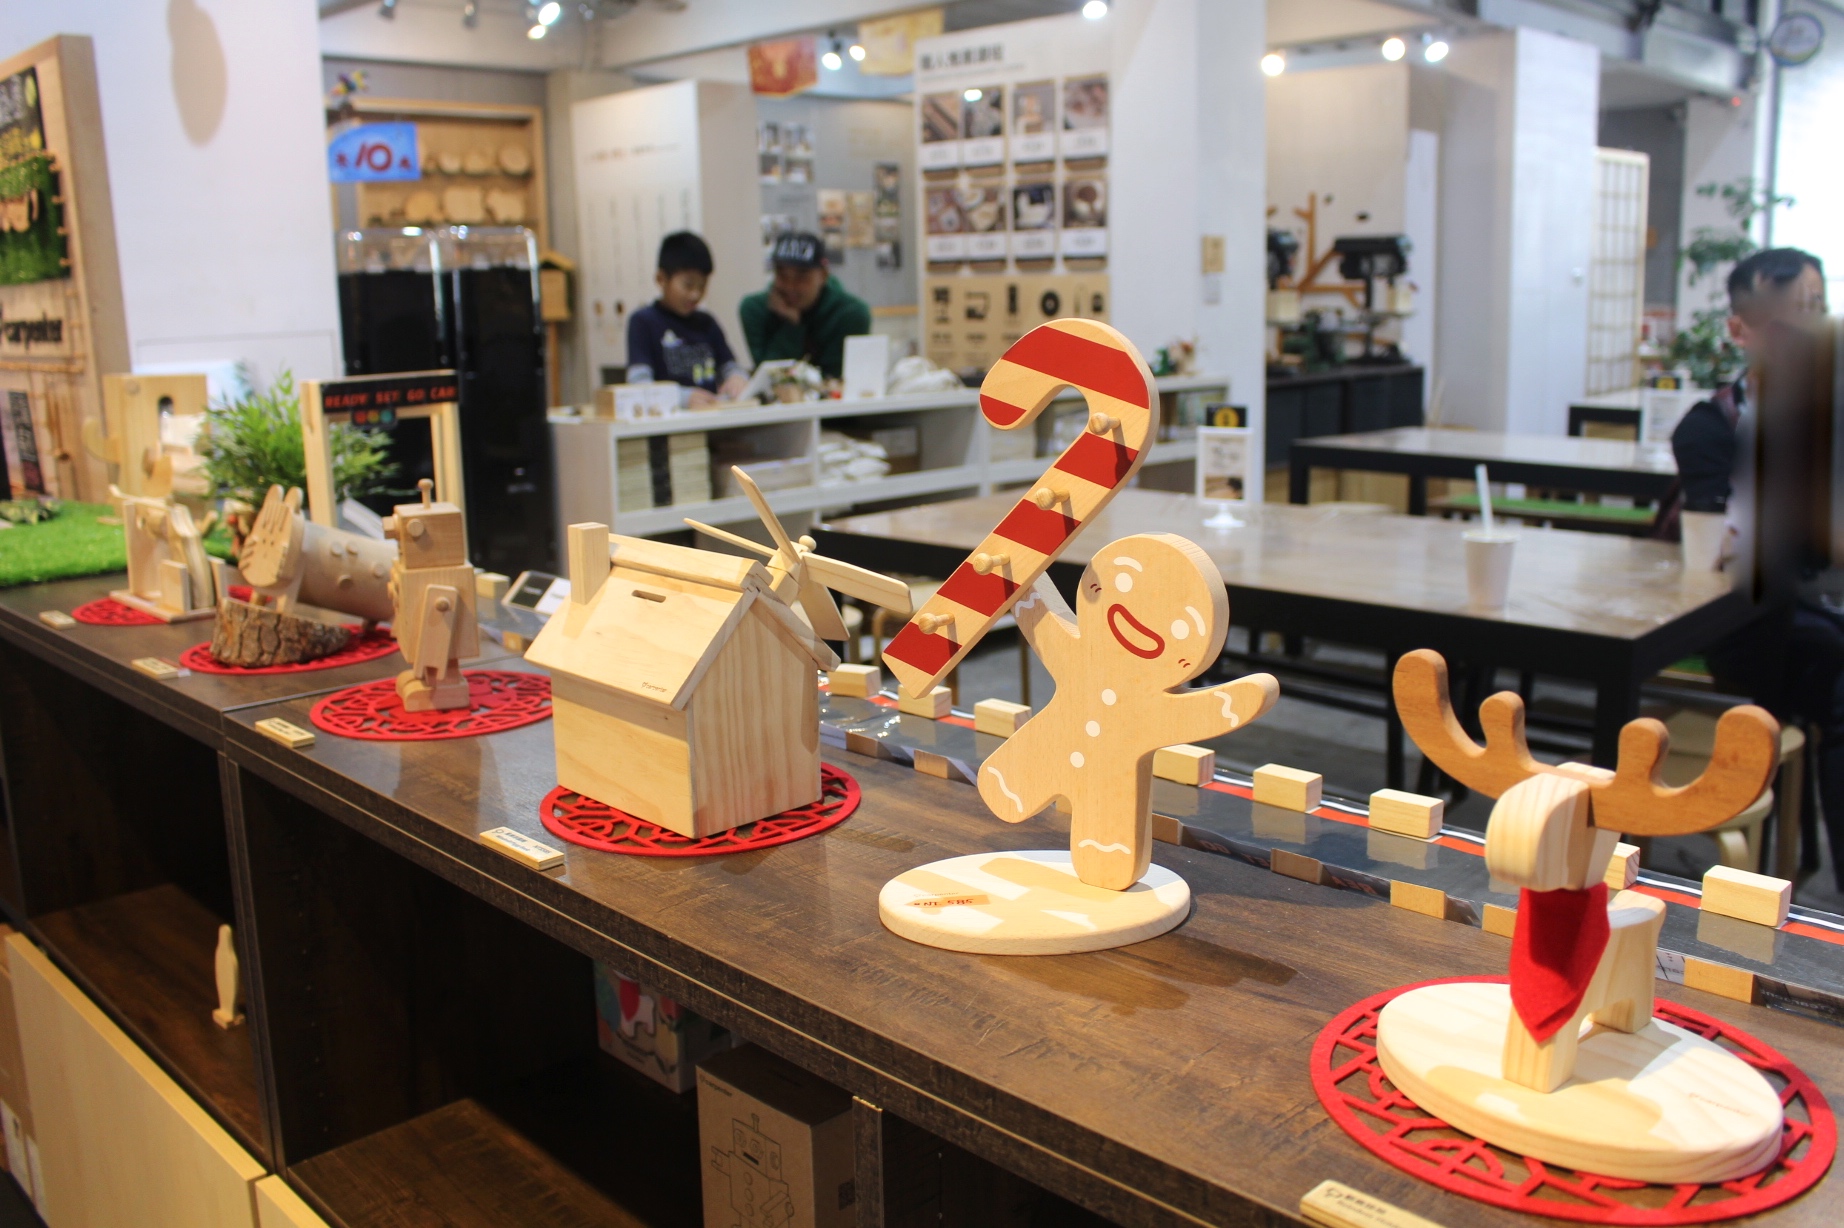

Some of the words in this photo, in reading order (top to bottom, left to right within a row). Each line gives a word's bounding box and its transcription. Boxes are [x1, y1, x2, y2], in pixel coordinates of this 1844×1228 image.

[324, 393, 369, 408] READY
[375, 390, 400, 404] SET
[406, 388, 425, 402] GO
[430, 386, 457, 400] CAR
